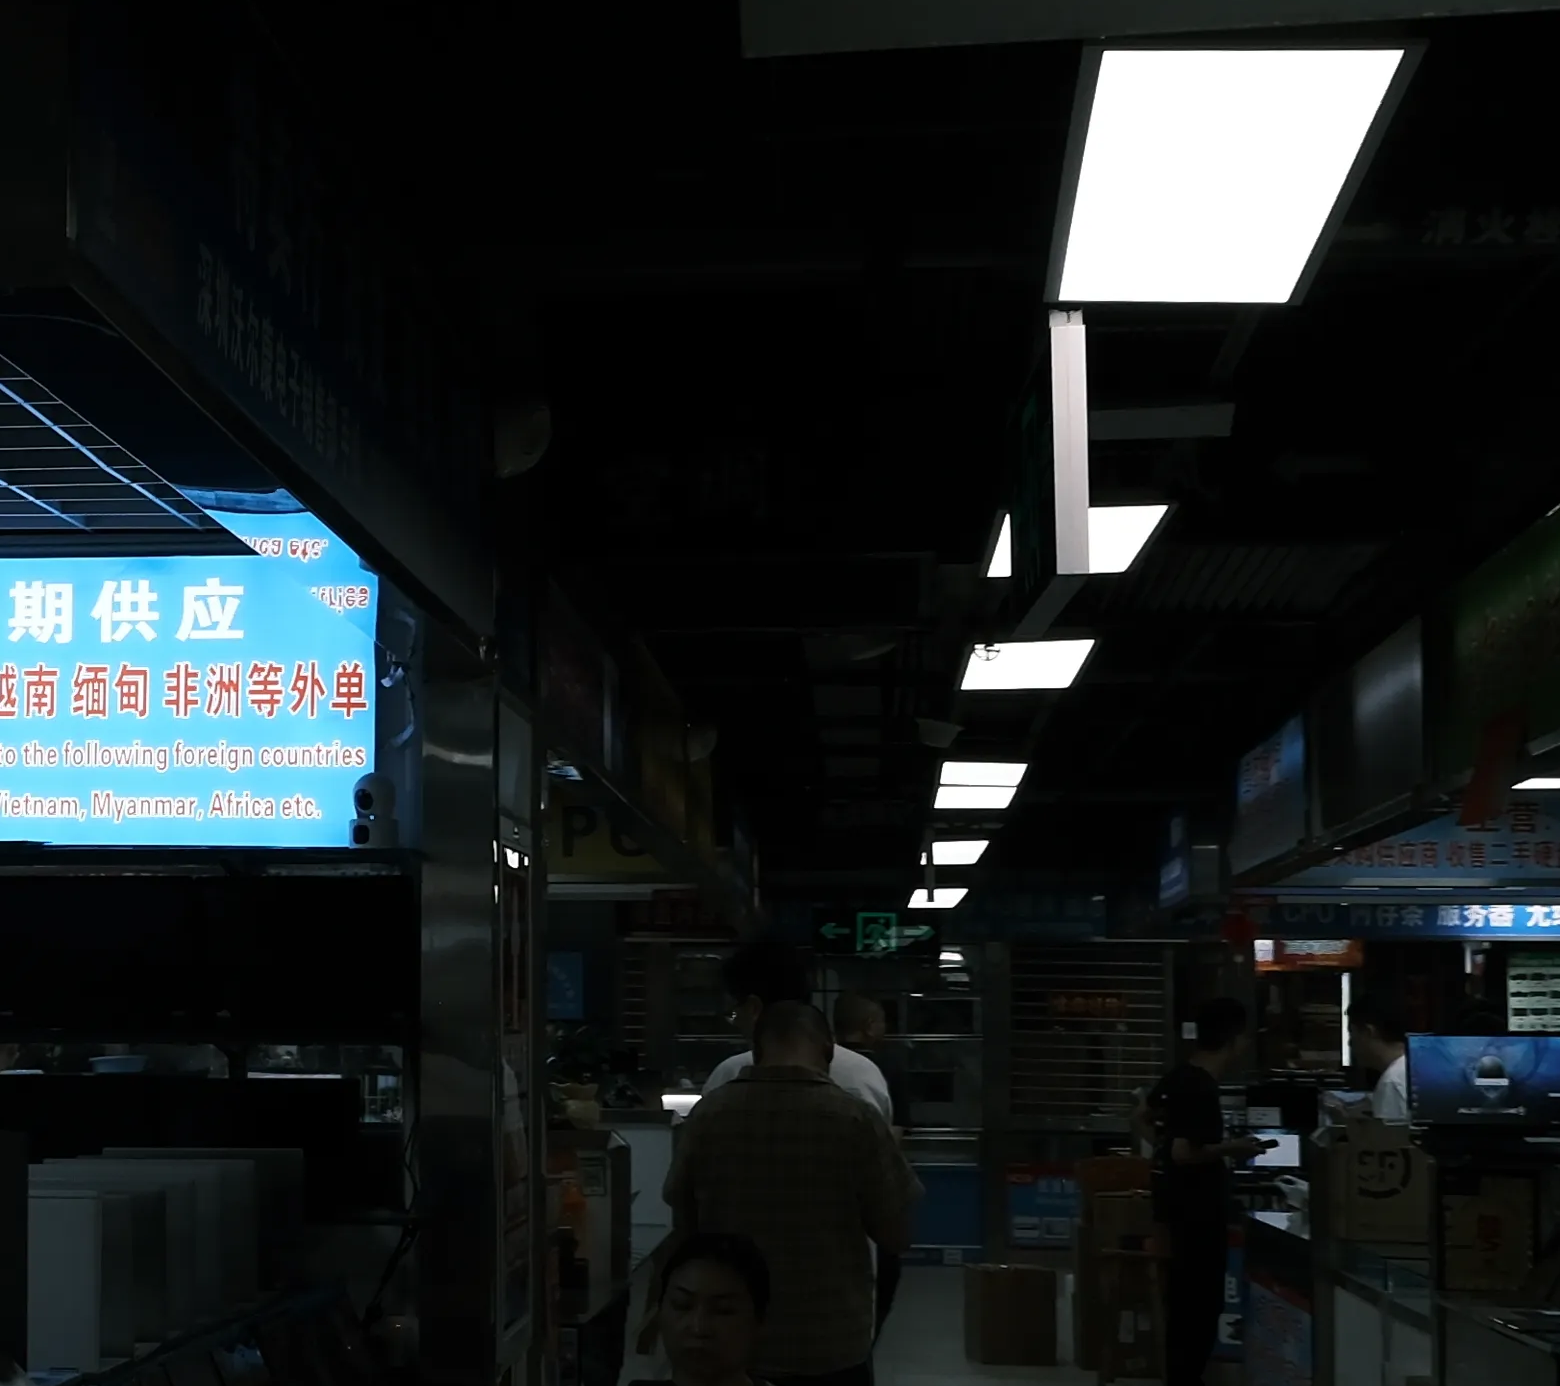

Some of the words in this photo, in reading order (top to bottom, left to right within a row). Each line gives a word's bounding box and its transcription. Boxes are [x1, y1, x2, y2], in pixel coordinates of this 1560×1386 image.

[70, 662, 151, 718] 缅甸
[163, 660, 369, 719] 非洲等外单
[22, 740, 58, 772] the
[62, 740, 169, 772] following
[172, 740, 255, 772] foreign
[259, 740, 366, 772] countries
[91, 787, 205, 823] Myanmar,
[208, 787, 276, 823] Africa
[281, 787, 323, 823] etc.
